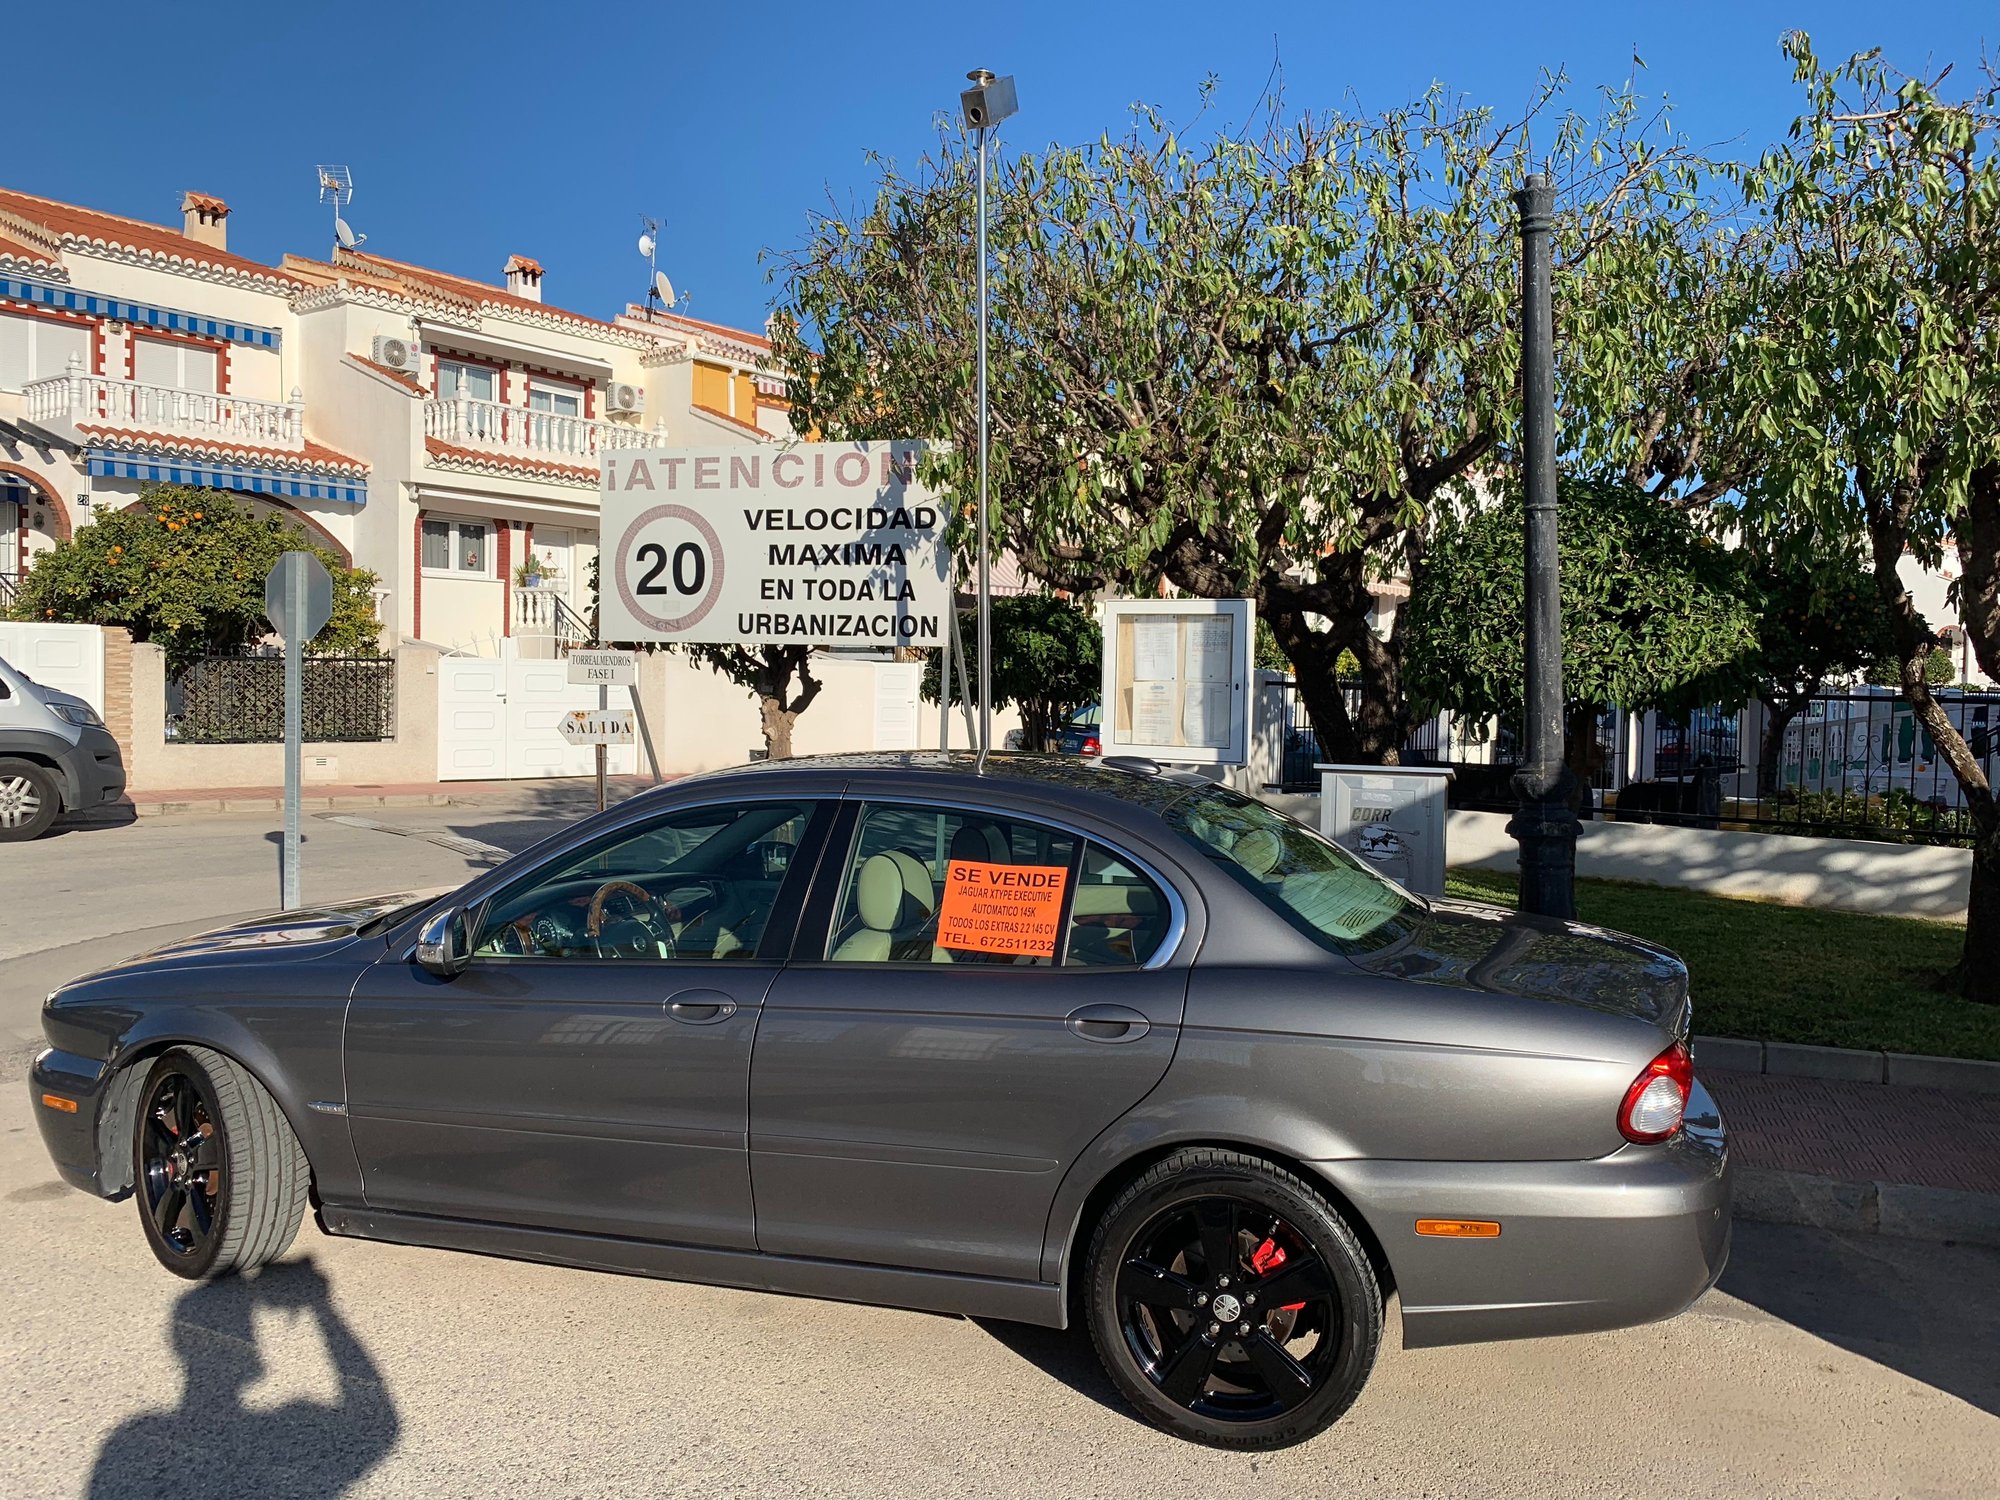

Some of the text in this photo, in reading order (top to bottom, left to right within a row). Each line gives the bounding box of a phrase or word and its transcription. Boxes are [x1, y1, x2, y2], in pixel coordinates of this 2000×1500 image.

[743, 507, 937, 530] VELOCIDAD
[768, 544, 907, 566] MAXIMA
[636, 542, 706, 596] 20
[760, 579, 916, 601] EN TODA LA
[738, 613, 938, 638] URBANIZACION
[572, 655, 631, 666] TORREALMENDROS
[587, 669, 615, 680] FASE I
[566, 721, 631, 734] SALIDA
[953, 867, 1061, 888] SE VENDE
[958, 886, 1052, 902] JAGUAR XTYPE EXECUTIVE
[971, 903, 1036, 917] AUTOMATICO 145K
[949, 916, 1055, 935] TODOS LOS EXTRAS 2.2 145 CV
[944, 932, 1054, 951] TEL. 672511232
